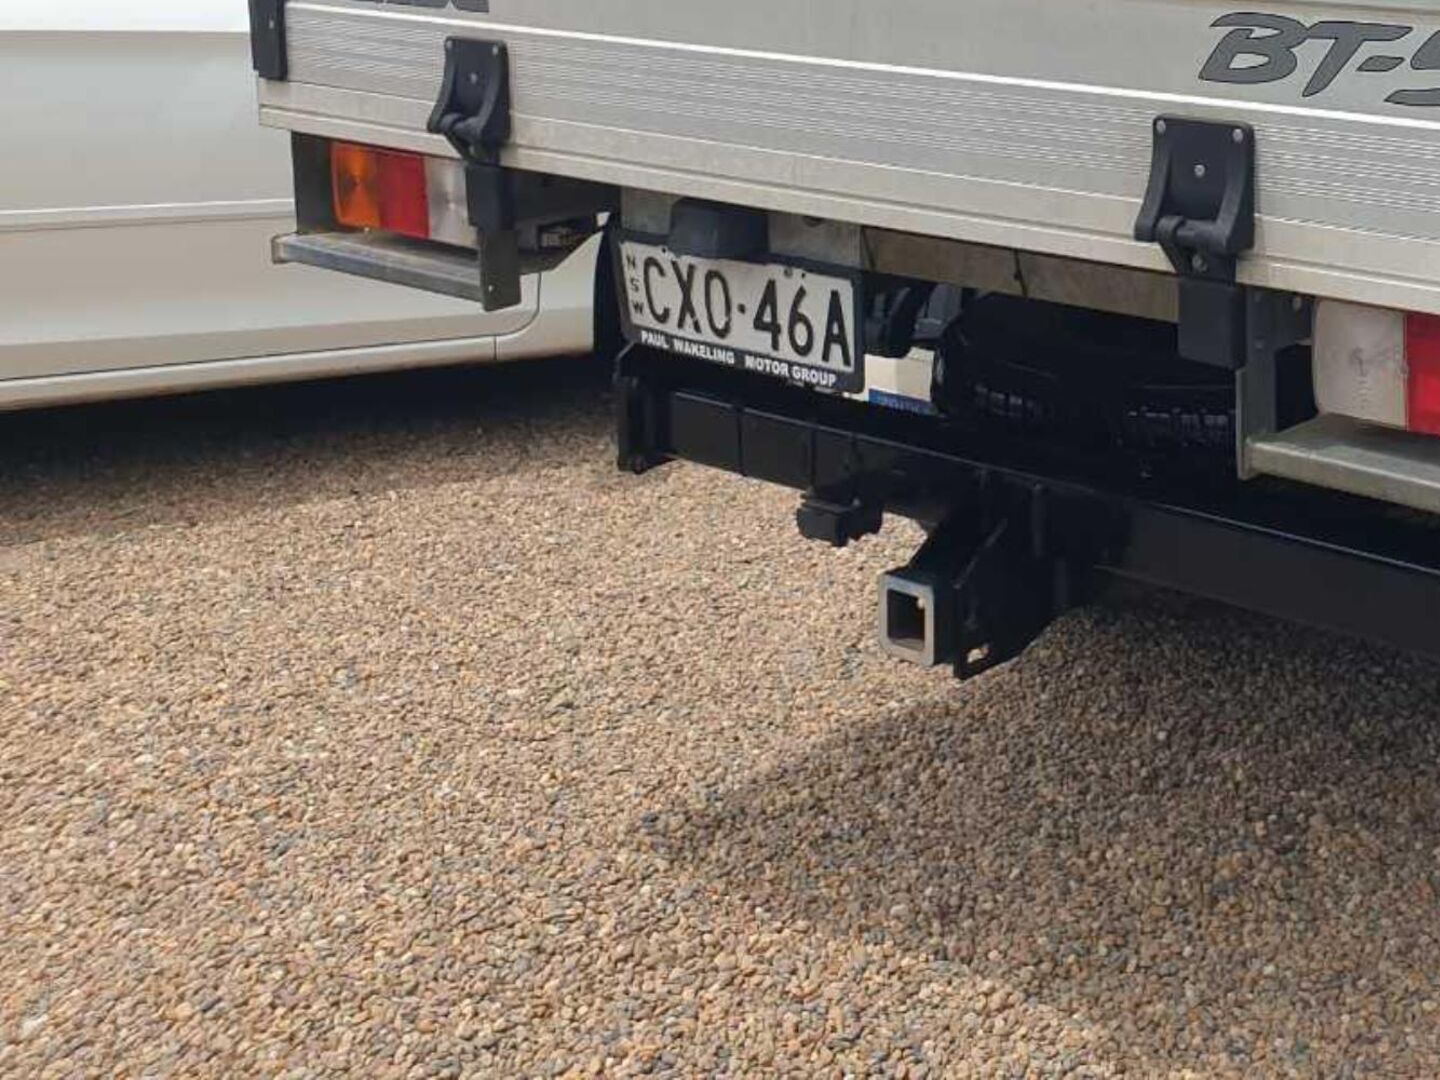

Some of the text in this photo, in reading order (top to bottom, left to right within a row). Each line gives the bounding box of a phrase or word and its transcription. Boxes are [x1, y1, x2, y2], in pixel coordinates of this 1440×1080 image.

[641, 329, 837, 388] PAUL WAKELING MOTOR GROUP
